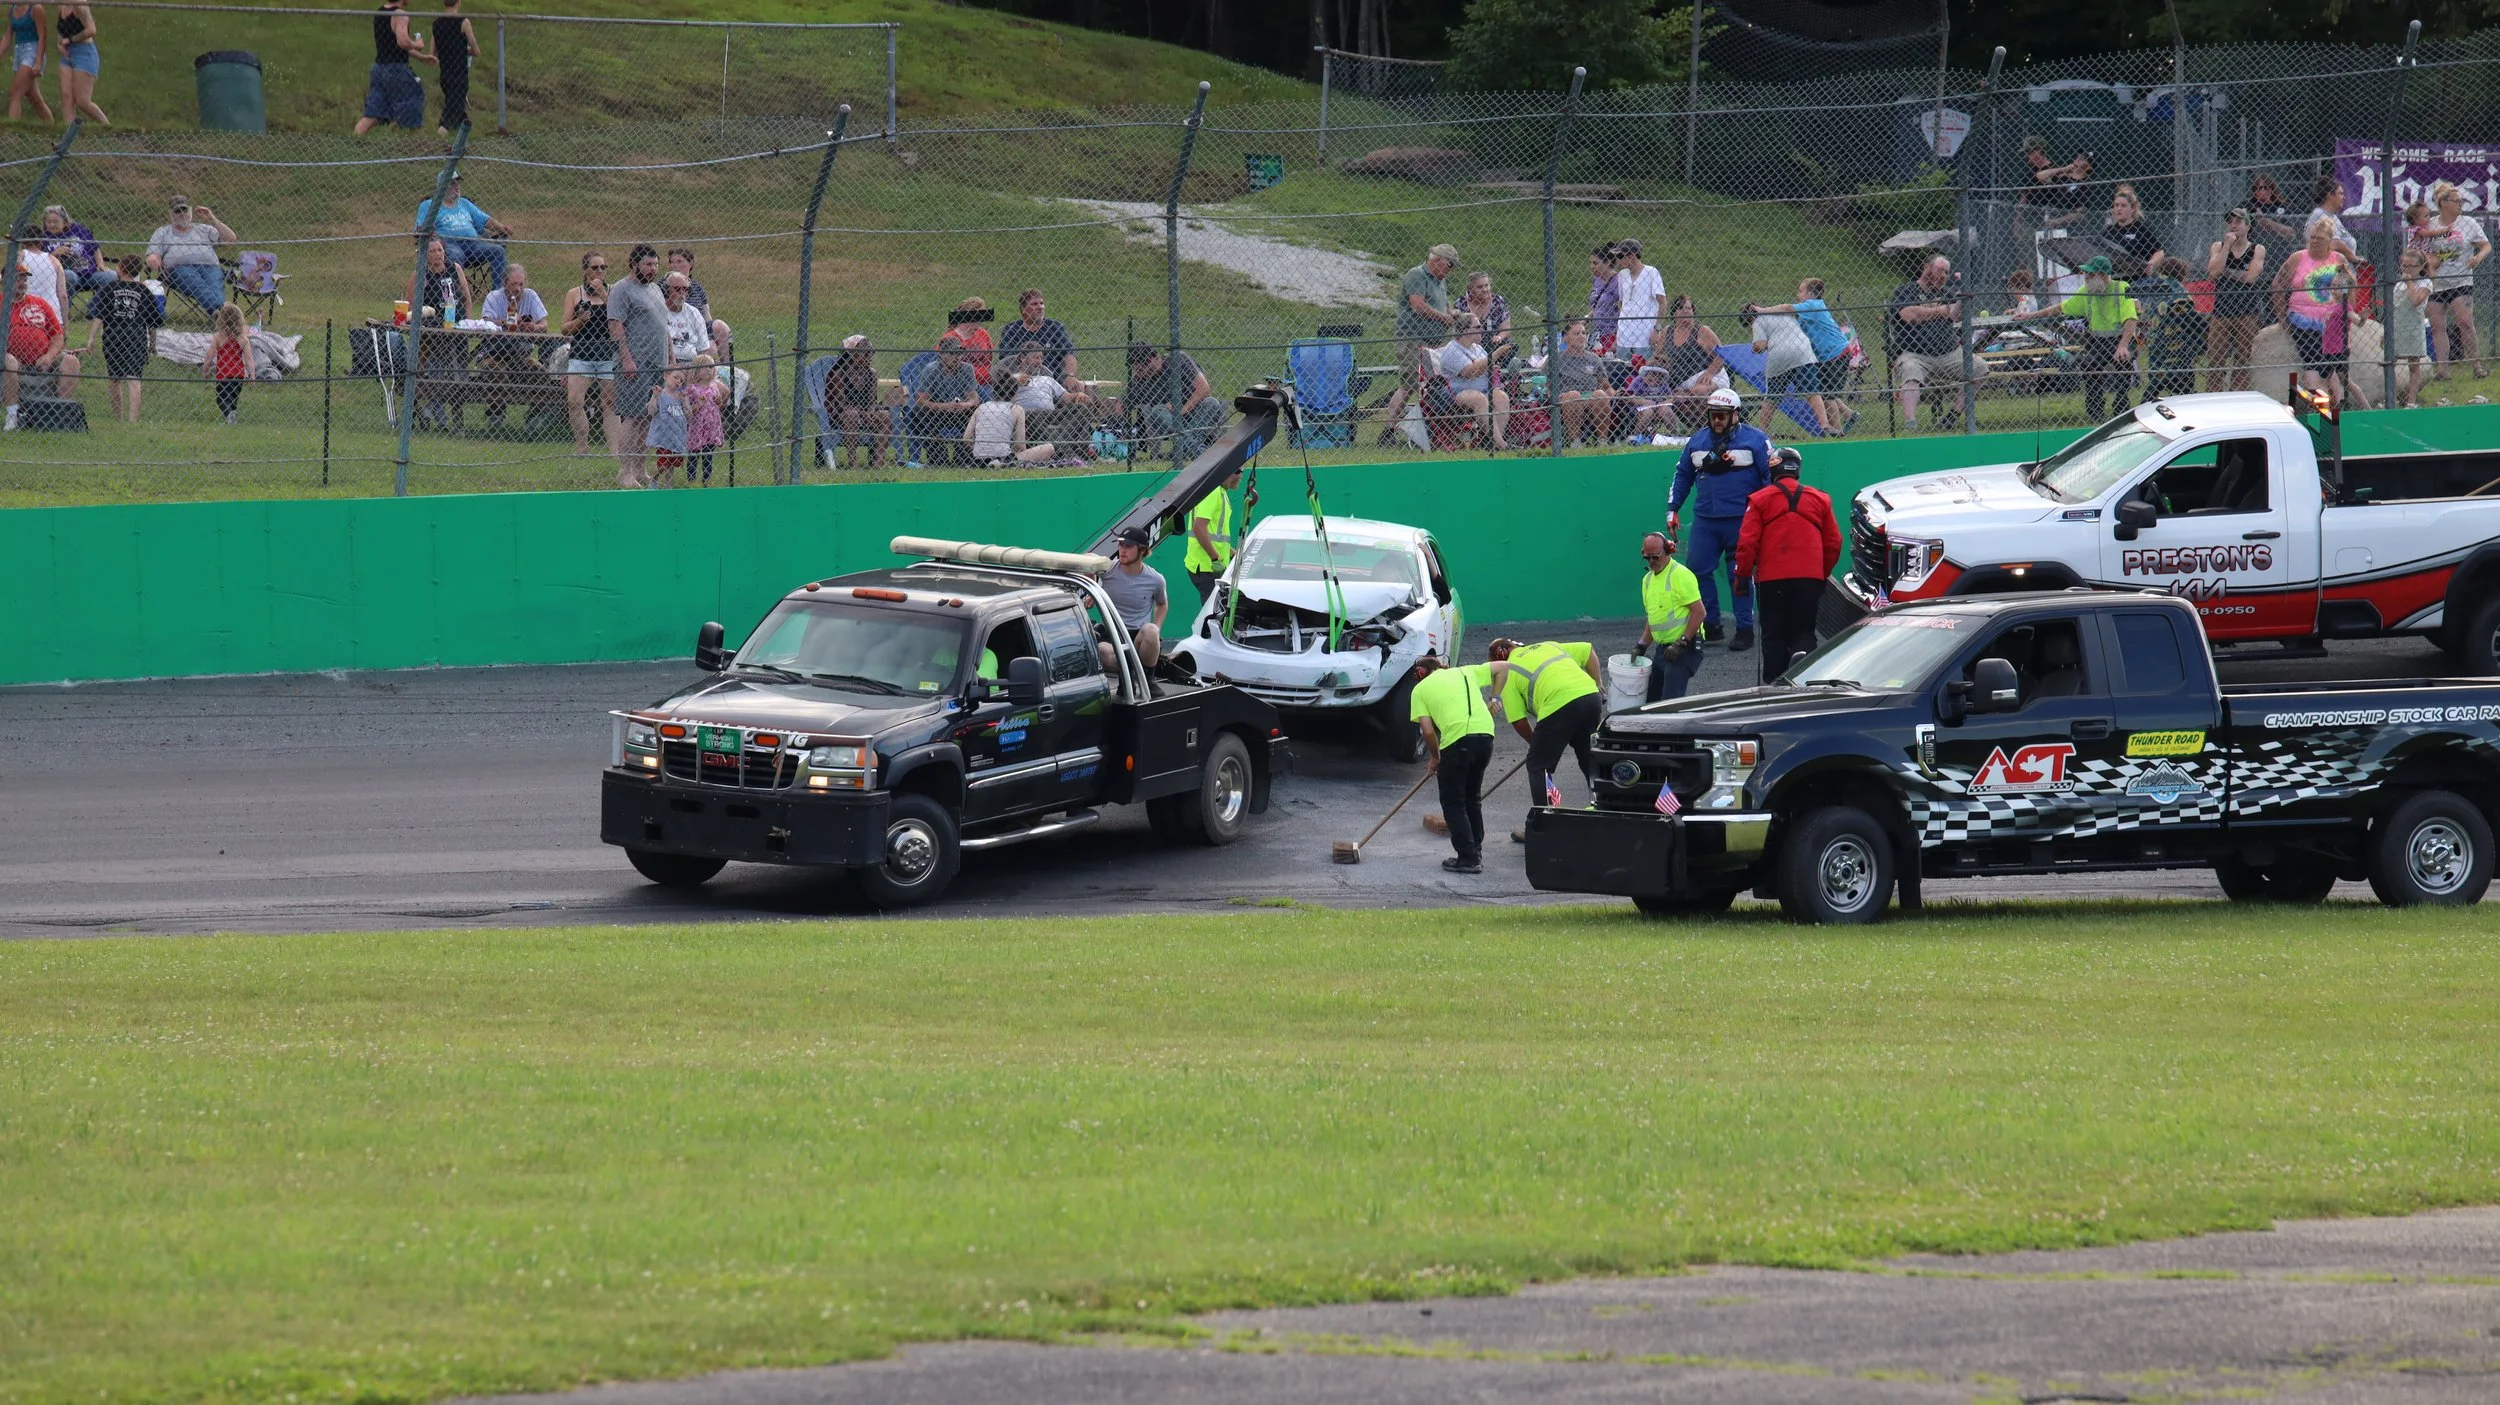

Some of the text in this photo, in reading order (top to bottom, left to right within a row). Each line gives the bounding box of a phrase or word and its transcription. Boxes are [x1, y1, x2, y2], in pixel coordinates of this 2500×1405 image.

[2361, 146, 2429, 162] WEOME
[1246, 435, 1262, 459] ATS
[2122, 544, 2272, 576] PRESTON'S
[2170, 578, 2227, 600] KIA
[2196, 605, 2256, 616] 8-0950
[2264, 710, 2386, 728] CHAMPIONSHIP
[2388, 707, 2444, 723] STOCK
[2446, 706, 2477, 721] CAR
[705, 734, 734, 743] VERMONT
[705, 740, 734, 749] STRONG
[2130, 734, 2200, 746] THUNDER ROAD
[703, 752, 750, 769] GMC
[1972, 743, 2077, 785] ACT
